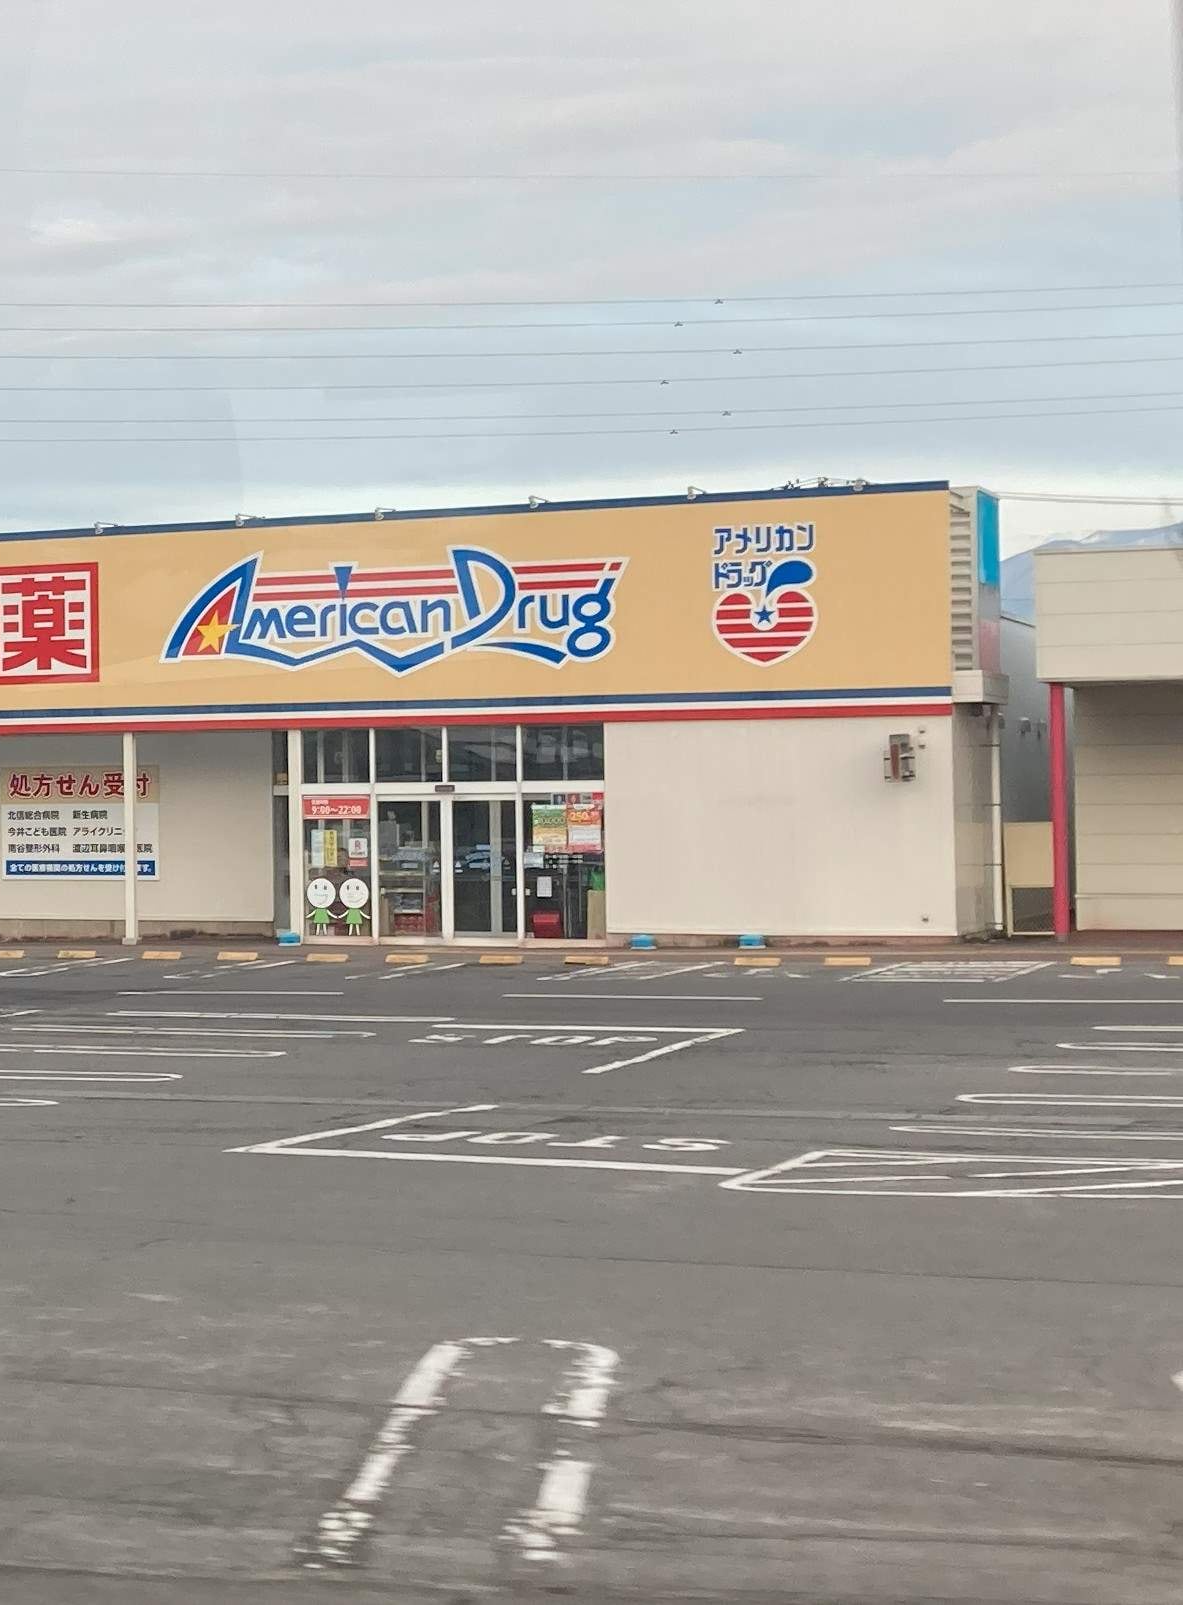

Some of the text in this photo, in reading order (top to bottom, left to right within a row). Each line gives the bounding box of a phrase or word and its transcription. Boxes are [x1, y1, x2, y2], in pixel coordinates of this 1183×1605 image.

[713, 523, 815, 555] アメリカン
[714, 559, 773, 590] ドラッグ
[0, 573, 89, 673] 薬
[161, 545, 619, 676] American Drug
[7, 827, 127, 837] 今井こども医院 アライクリニ
[380, 1130, 733, 1153] STOP
